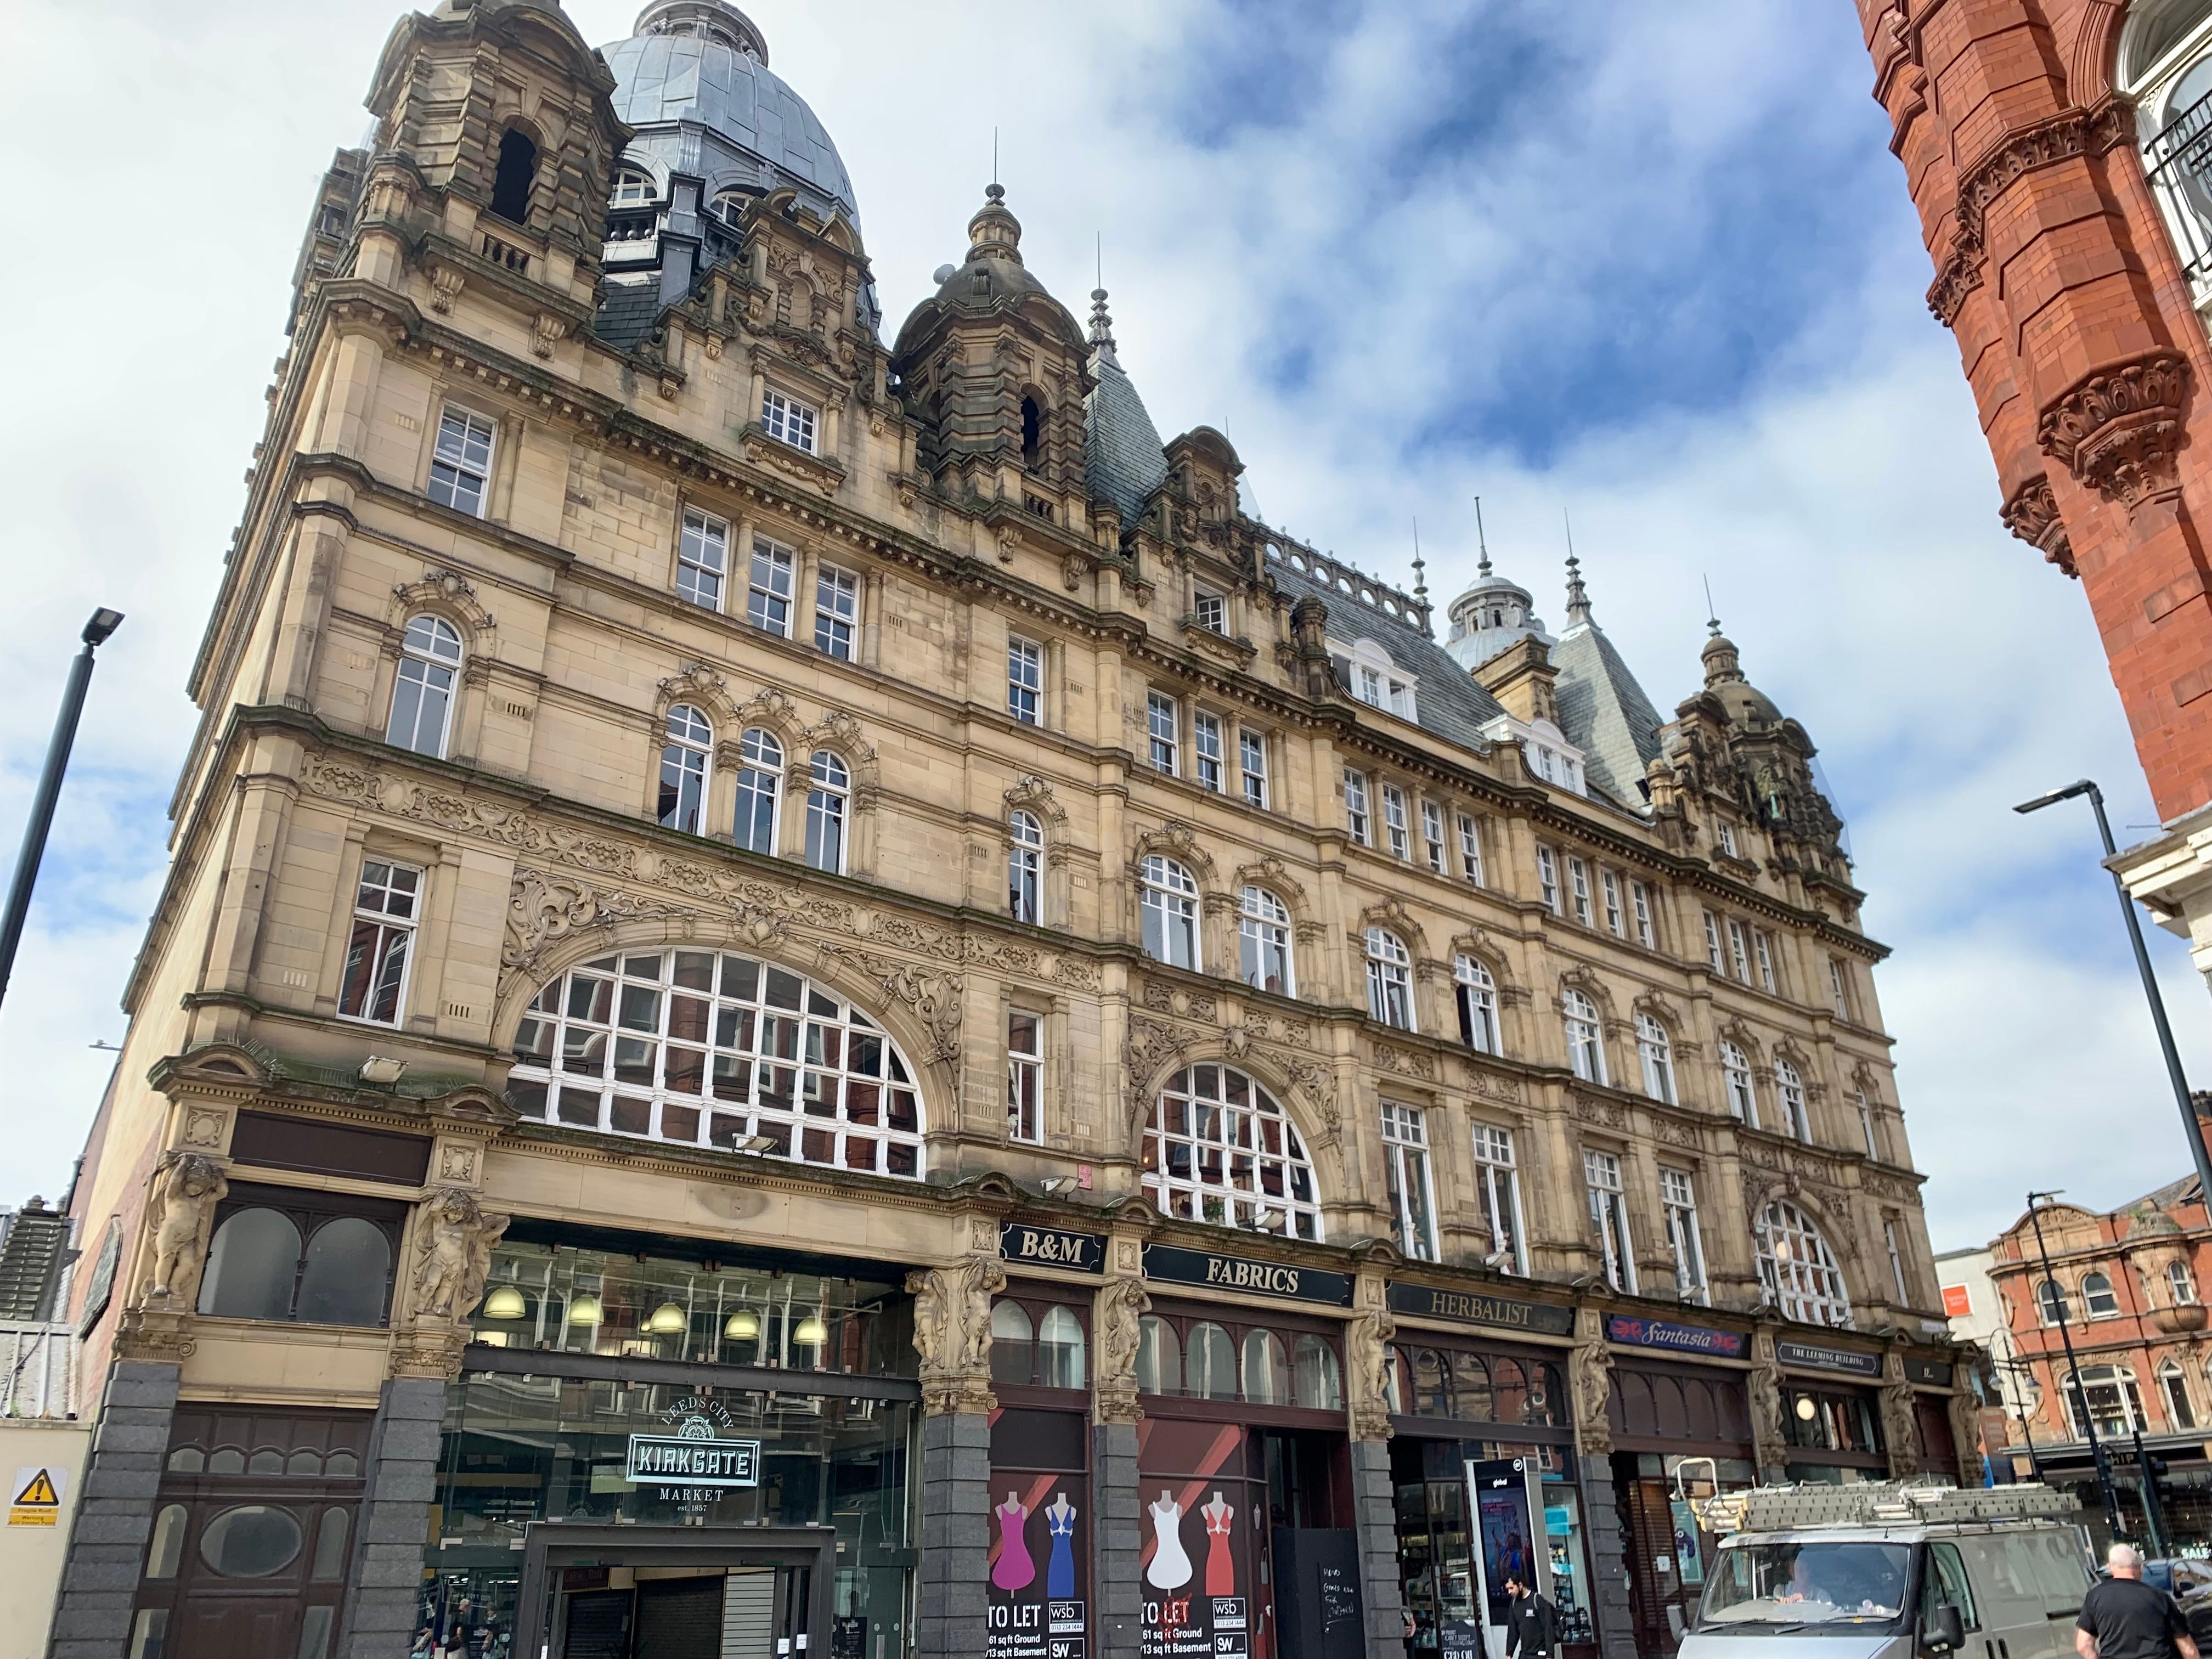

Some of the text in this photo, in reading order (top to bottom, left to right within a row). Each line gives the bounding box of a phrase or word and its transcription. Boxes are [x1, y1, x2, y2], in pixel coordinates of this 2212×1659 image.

[1019, 1231, 1085, 1263] B&M
[1206, 1257, 1299, 1294] FABRICS
[1431, 1291, 1532, 1325] HERBALIST
[1642, 1322, 1712, 1348] Fantasia
[1792, 1347, 1804, 1358] THE
[1806, 1350, 1834, 1362] LEEMING
[1835, 1353, 1864, 1367] BUILDING
[661, 1396, 734, 1430] LEEDS CITY
[637, 1446, 750, 1476] KIRKGATE
[659, 1487, 724, 1502] MARKET
[691, 1504, 707, 1513] 1857
[988, 1605, 1041, 1628] TO LET
[1051, 1603, 1075, 1618] wsb
[1141, 1601, 1189, 1625] TO LET
[1215, 1599, 1237, 1615] wsb
[998, 1637, 1007, 1646] sq
[1007, 1634, 1013, 1644] ft
[1014, 1633, 1041, 1644] Ground
[1153, 1632, 1163, 1641] sq
[1172, 1627, 1203, 1639] Ground
[997, 1650, 1006, 1659] sq
[1007, 1647, 1013, 1658] ft
[1013, 1646, 1047, 1657] Basement
[1153, 1646, 1163, 1656] sq
[1164, 1643, 1171, 1654] ft
[1172, 1641, 1212, 1654] Basement
